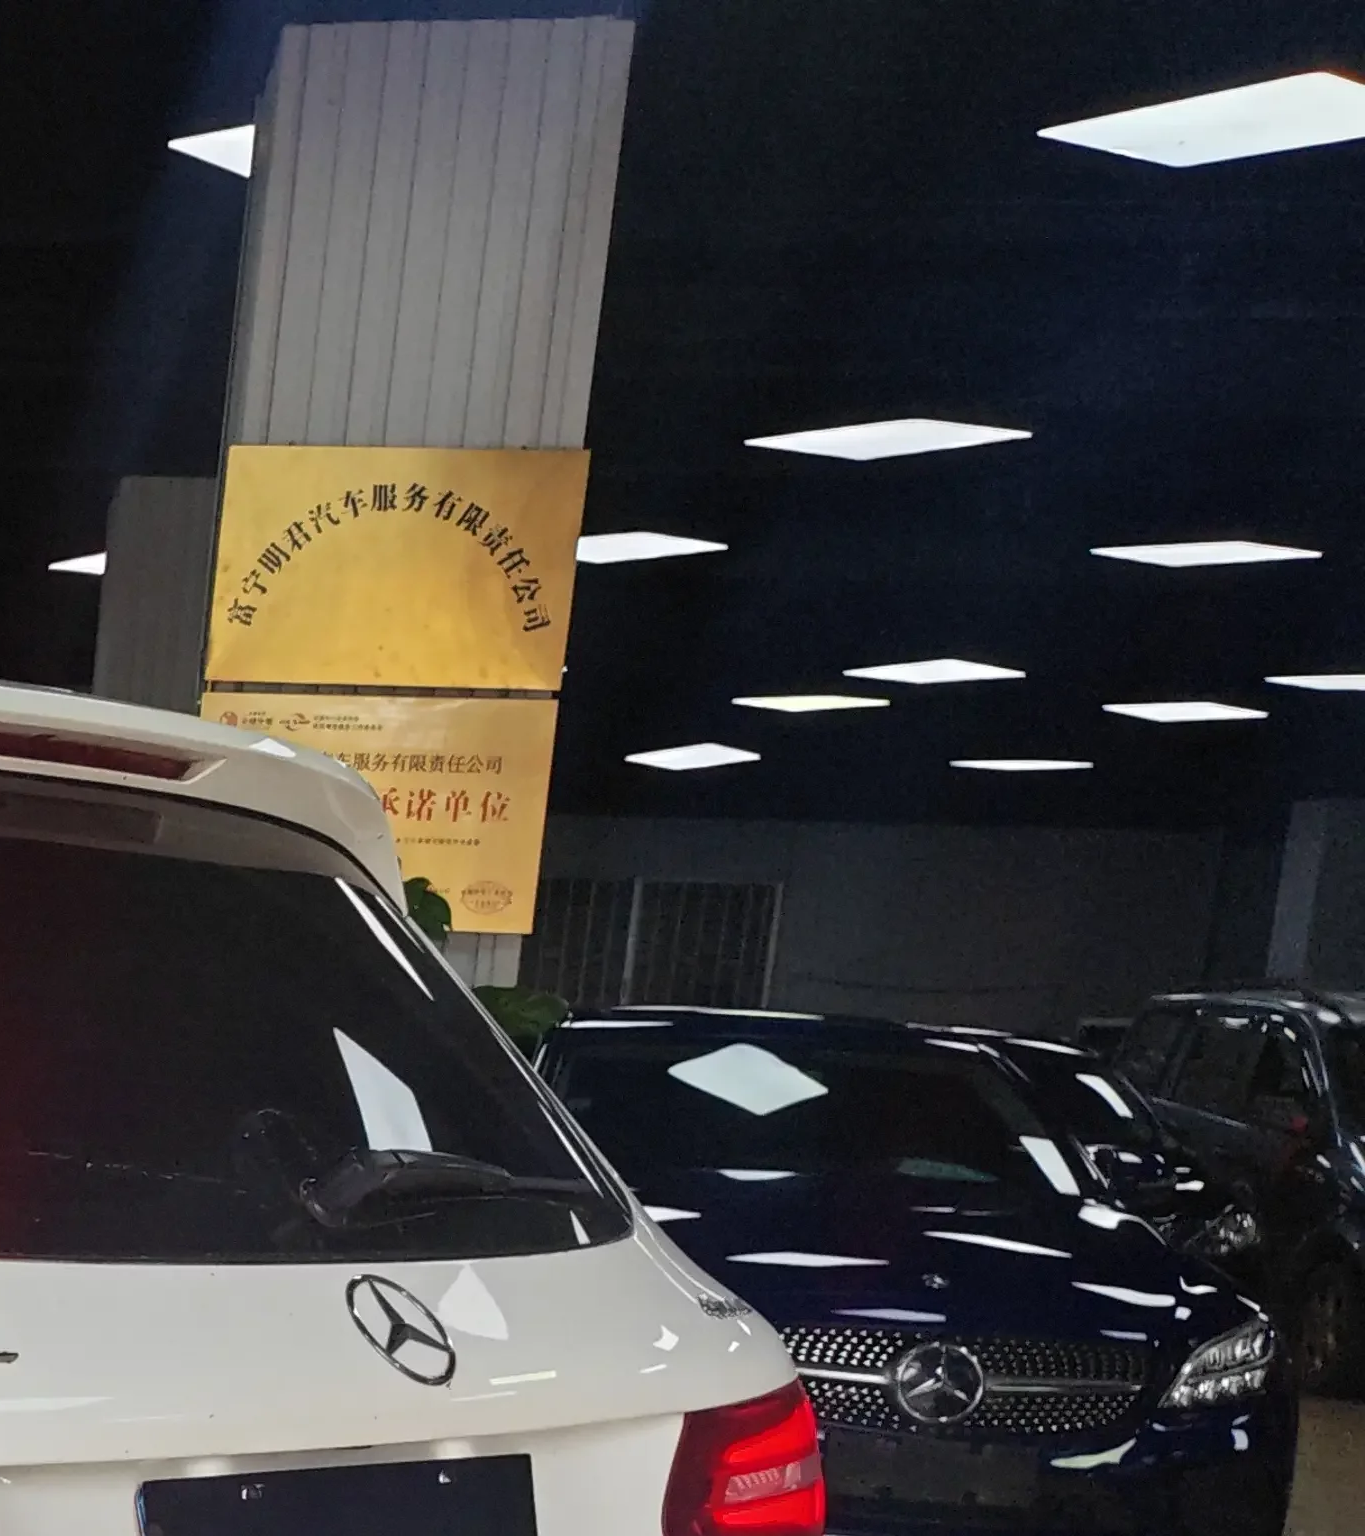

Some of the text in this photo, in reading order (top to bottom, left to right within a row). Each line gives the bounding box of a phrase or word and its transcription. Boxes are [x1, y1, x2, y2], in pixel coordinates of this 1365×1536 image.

[227, 482, 551, 632] 富宁明君汽车服务有限责任公司
[323, 751, 504, 775] 车服务有限责任公司
